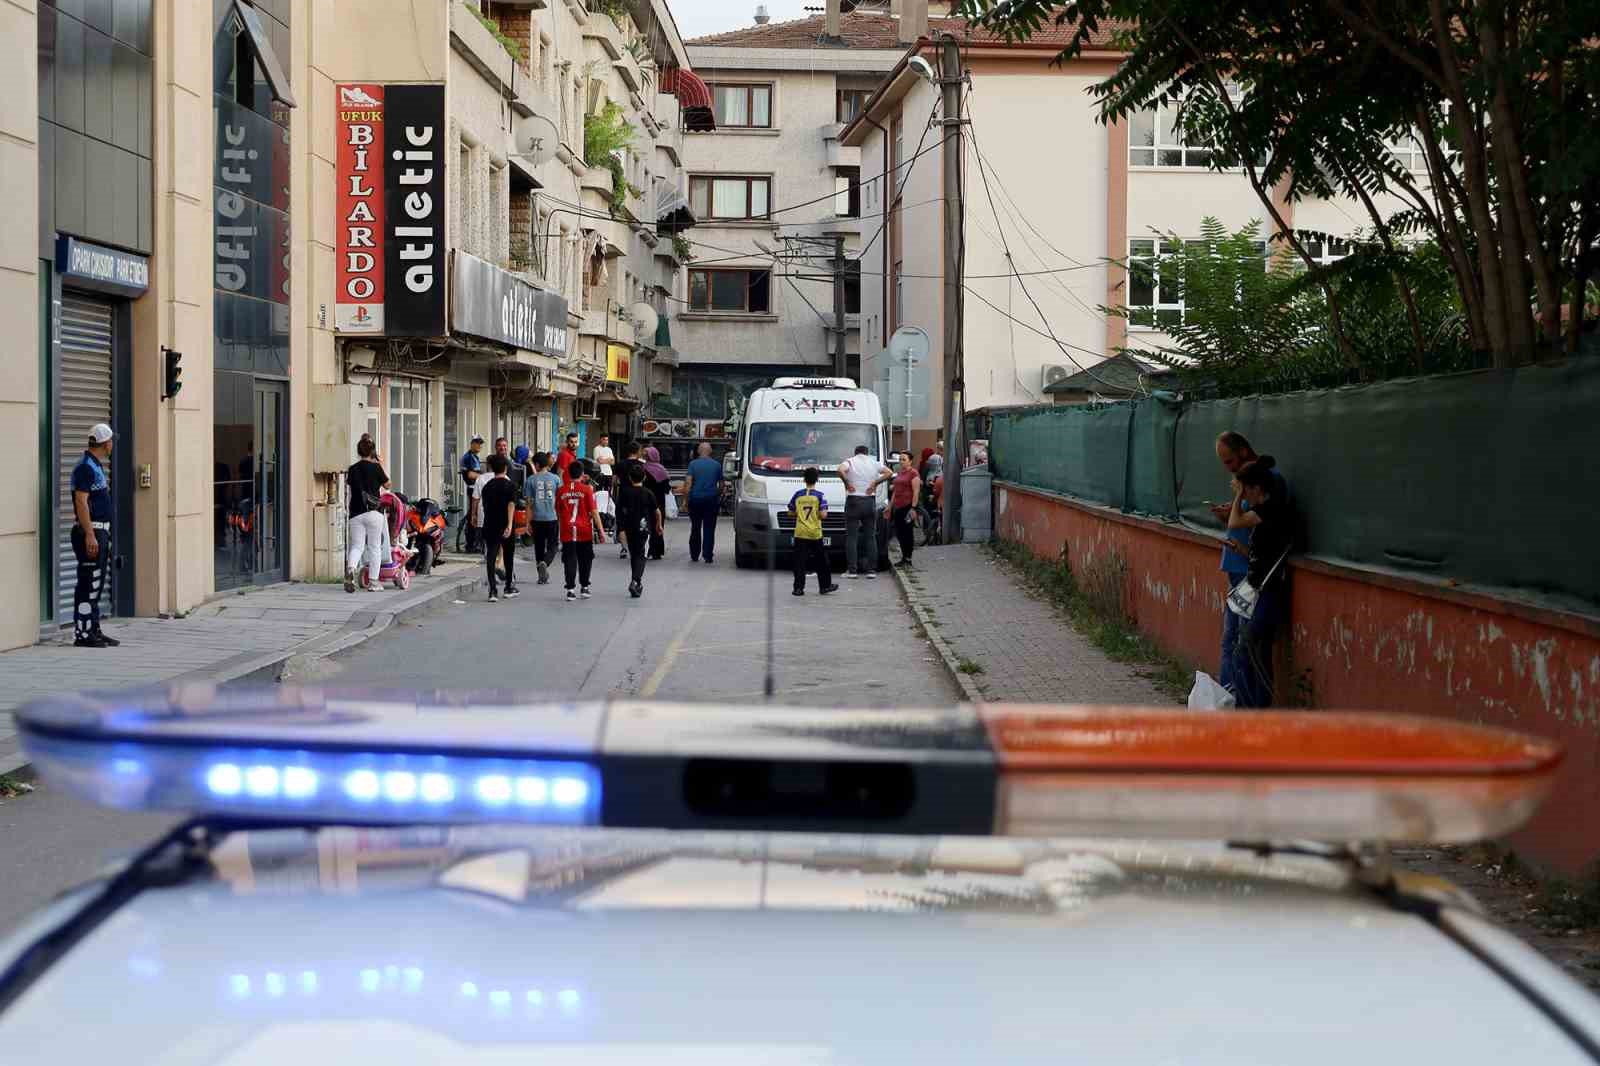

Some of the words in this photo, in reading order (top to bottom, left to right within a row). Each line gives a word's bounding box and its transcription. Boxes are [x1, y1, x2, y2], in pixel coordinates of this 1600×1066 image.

[340, 111, 382, 121] UFUK
[346, 124, 376, 299] BİLARDO
[392, 126, 434, 293] atletic
[502, 285, 536, 348] atletic
[567, 498, 579, 523] 7
[802, 505, 813, 521] 7
